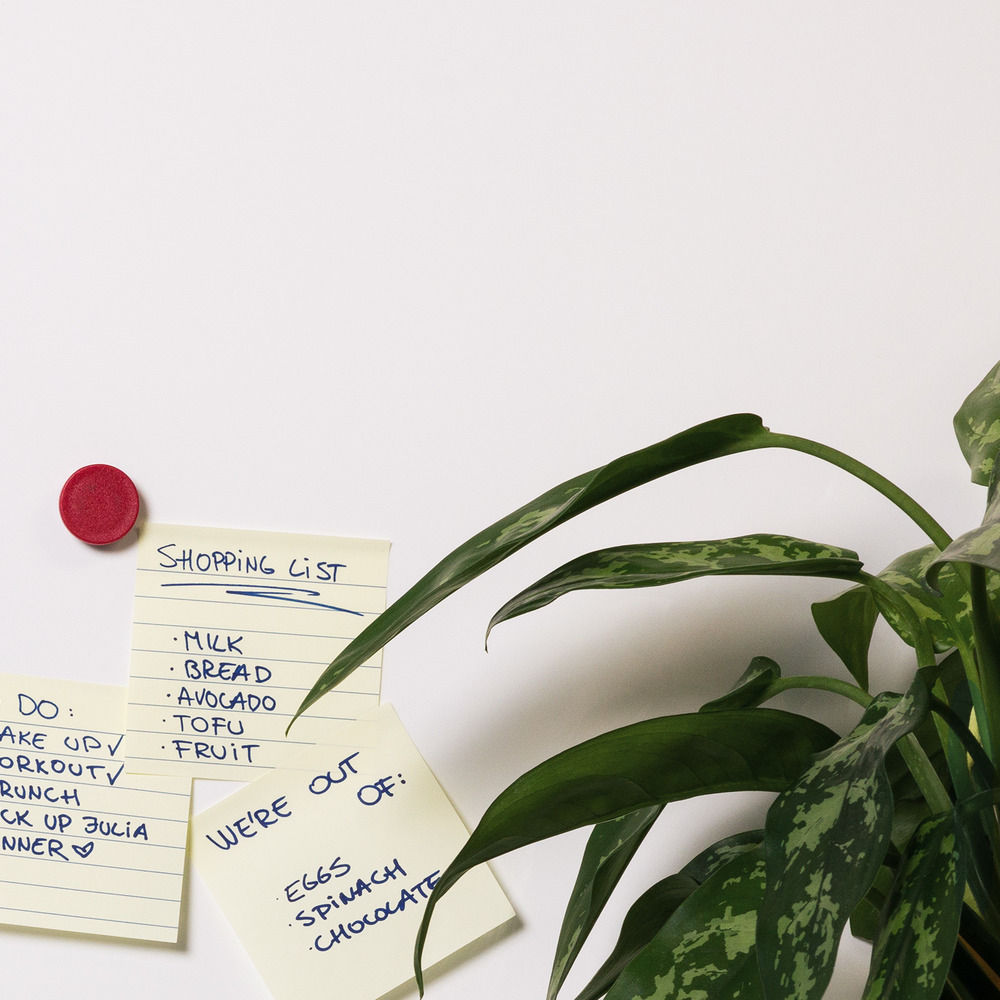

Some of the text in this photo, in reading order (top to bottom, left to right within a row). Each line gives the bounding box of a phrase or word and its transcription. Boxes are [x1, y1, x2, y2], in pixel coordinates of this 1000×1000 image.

[184, 631, 244, 656] MILK
[185, 659, 272, 684] BREAD
[178, 687, 277, 713] AVOCADO
[173, 714, 245, 736] TOFU
[64, 736, 102, 753] UP
[206, 752, 360, 851] WE'RE OUT
[357, 773, 407, 806] OF:
[44, 814, 73, 833] UP
[285, 857, 351, 903] EGGS
[314, 870, 441, 952] CHOCOLATE
